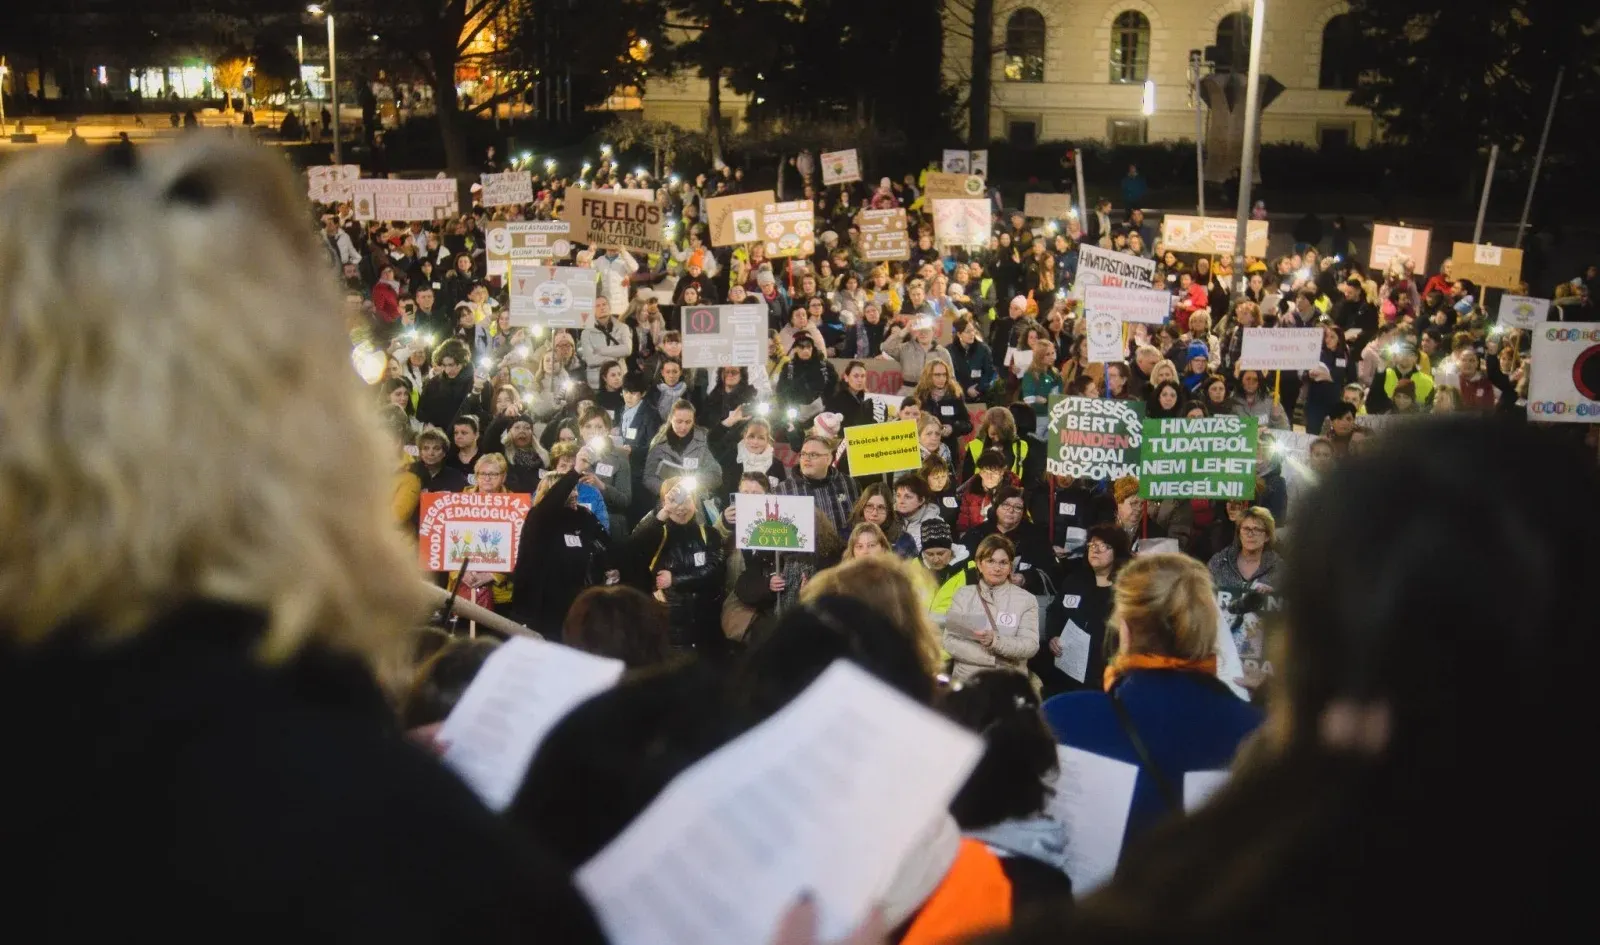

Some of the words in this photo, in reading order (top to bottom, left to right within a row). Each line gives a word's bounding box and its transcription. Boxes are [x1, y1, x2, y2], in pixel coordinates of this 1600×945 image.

[582, 198, 660, 225] FELELŐS
[1066, 412, 1119, 433] BÉRT
[1060, 430, 1130, 449] MINDEN
[1149, 434, 1253, 453] TUDATBÓL
[1059, 443, 1124, 463] ÓVODAI
[1143, 459, 1187, 475] NEM
[1192, 457, 1257, 475] LEHET
[1150, 477, 1243, 497] MEGÉLNI!
